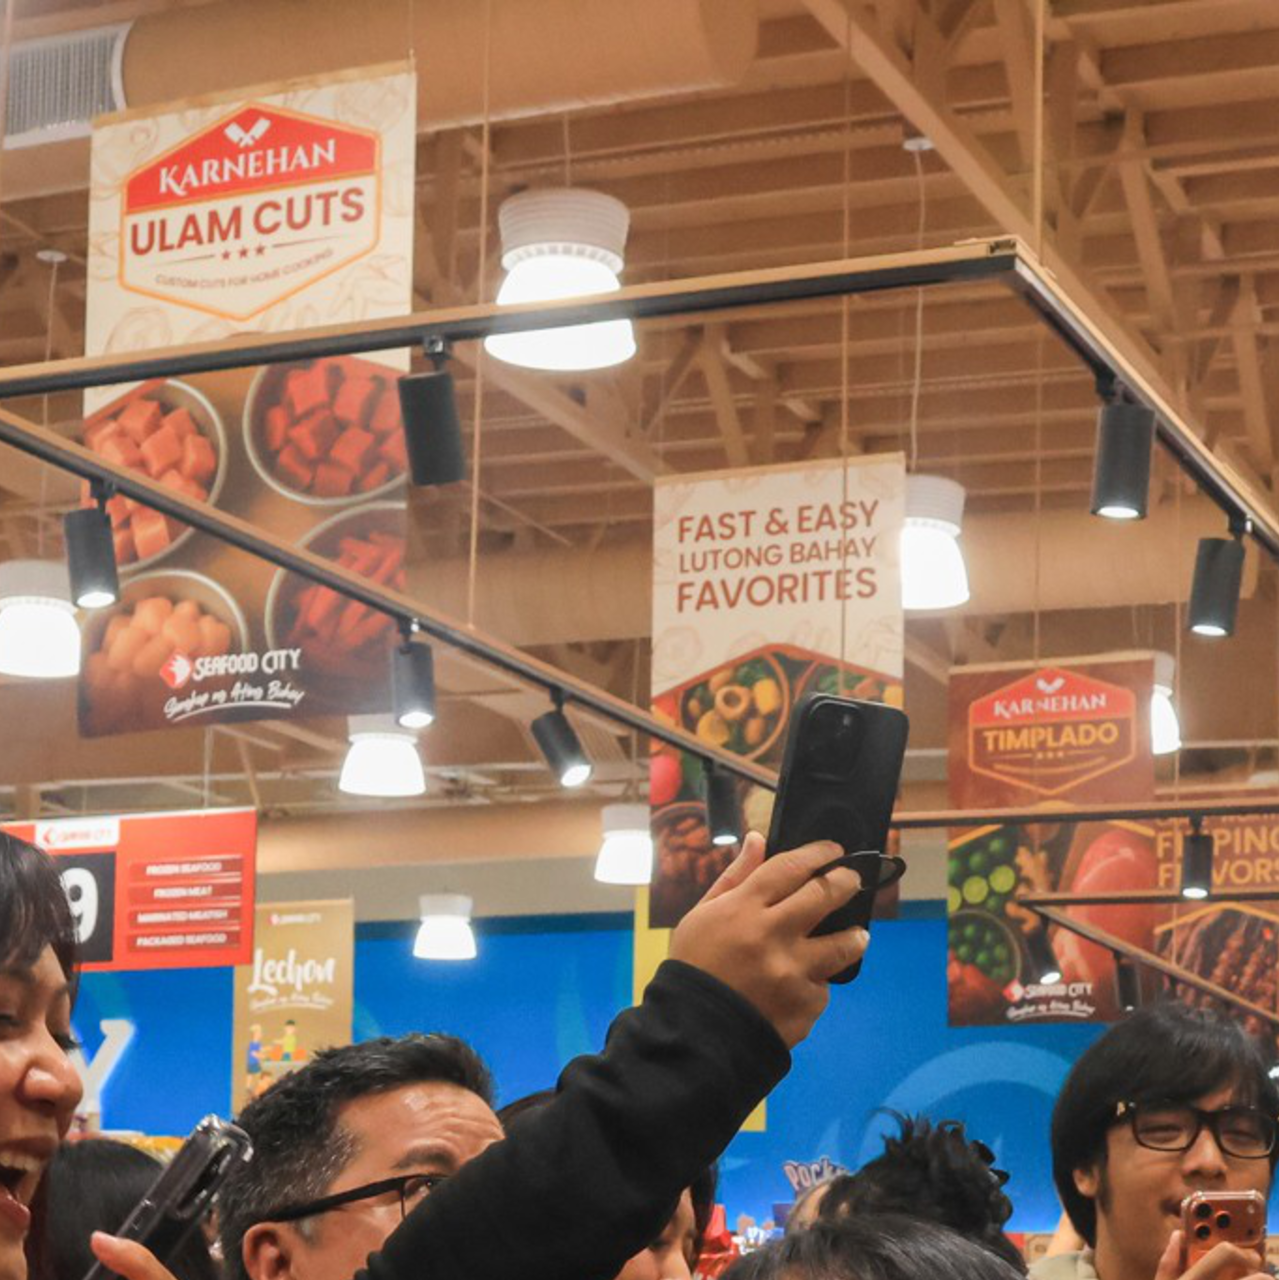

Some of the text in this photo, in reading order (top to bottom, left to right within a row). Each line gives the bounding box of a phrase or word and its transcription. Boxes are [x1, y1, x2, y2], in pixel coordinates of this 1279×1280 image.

[158, 139, 336, 197] KARNEHAN
[131, 187, 365, 256] ULAM CUTS
[678, 499, 879, 543] FAST & EASY
[679, 536, 877, 574] LUTONG BAHAY
[677, 567, 878, 613] FAVORITES
[192, 648, 301, 681] SEAFOOD CITY
[993, 693, 1107, 719] KARNEHAN
[982, 721, 1119, 753] TIMPLADO
[58, 867, 98, 944] 9
[247, 948, 336, 997] Lechon
